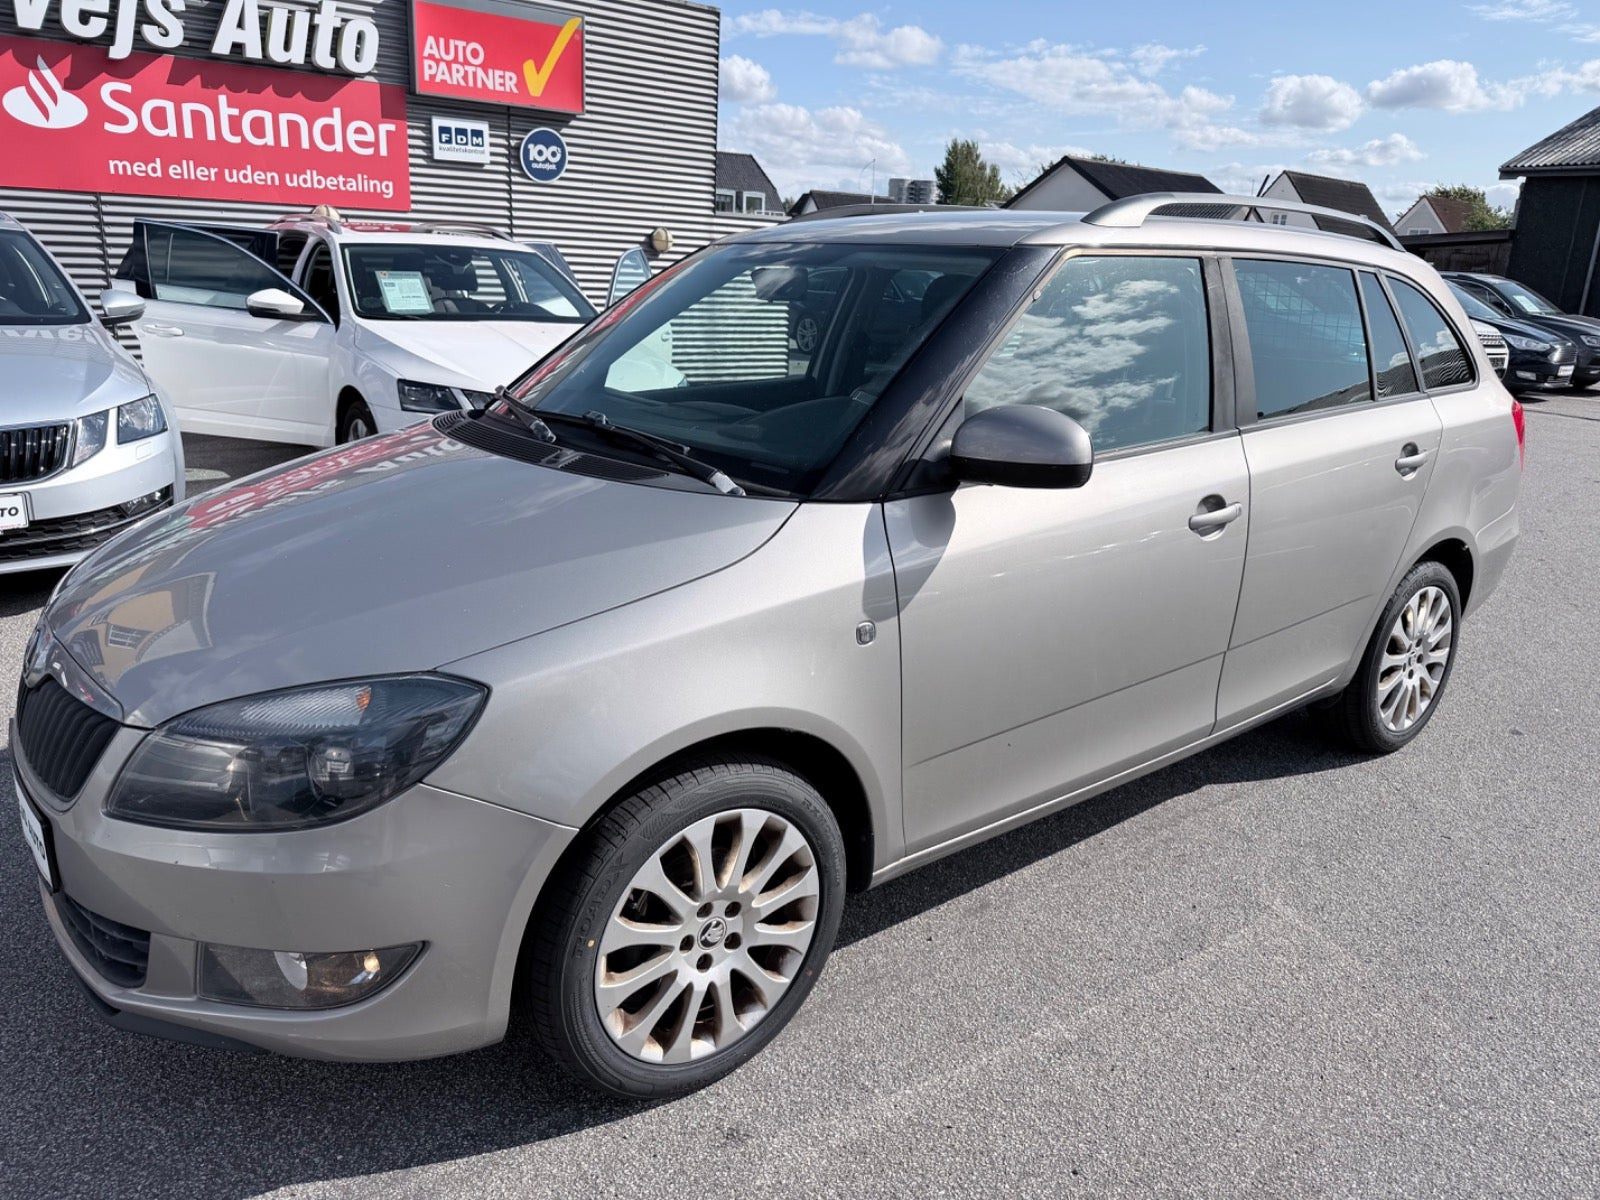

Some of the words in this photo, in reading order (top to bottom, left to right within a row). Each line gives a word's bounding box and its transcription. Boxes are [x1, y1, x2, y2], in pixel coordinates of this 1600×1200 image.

[211, 0, 379, 74] Auto
[422, 35, 485, 66] AUTO
[423, 59, 519, 94] PARTNER
[99, 81, 396, 157] Santander
[108, 157, 162, 179] med
[168, 160, 218, 182] eller
[224, 165, 280, 187] uden
[285, 169, 394, 199] udbetaling
